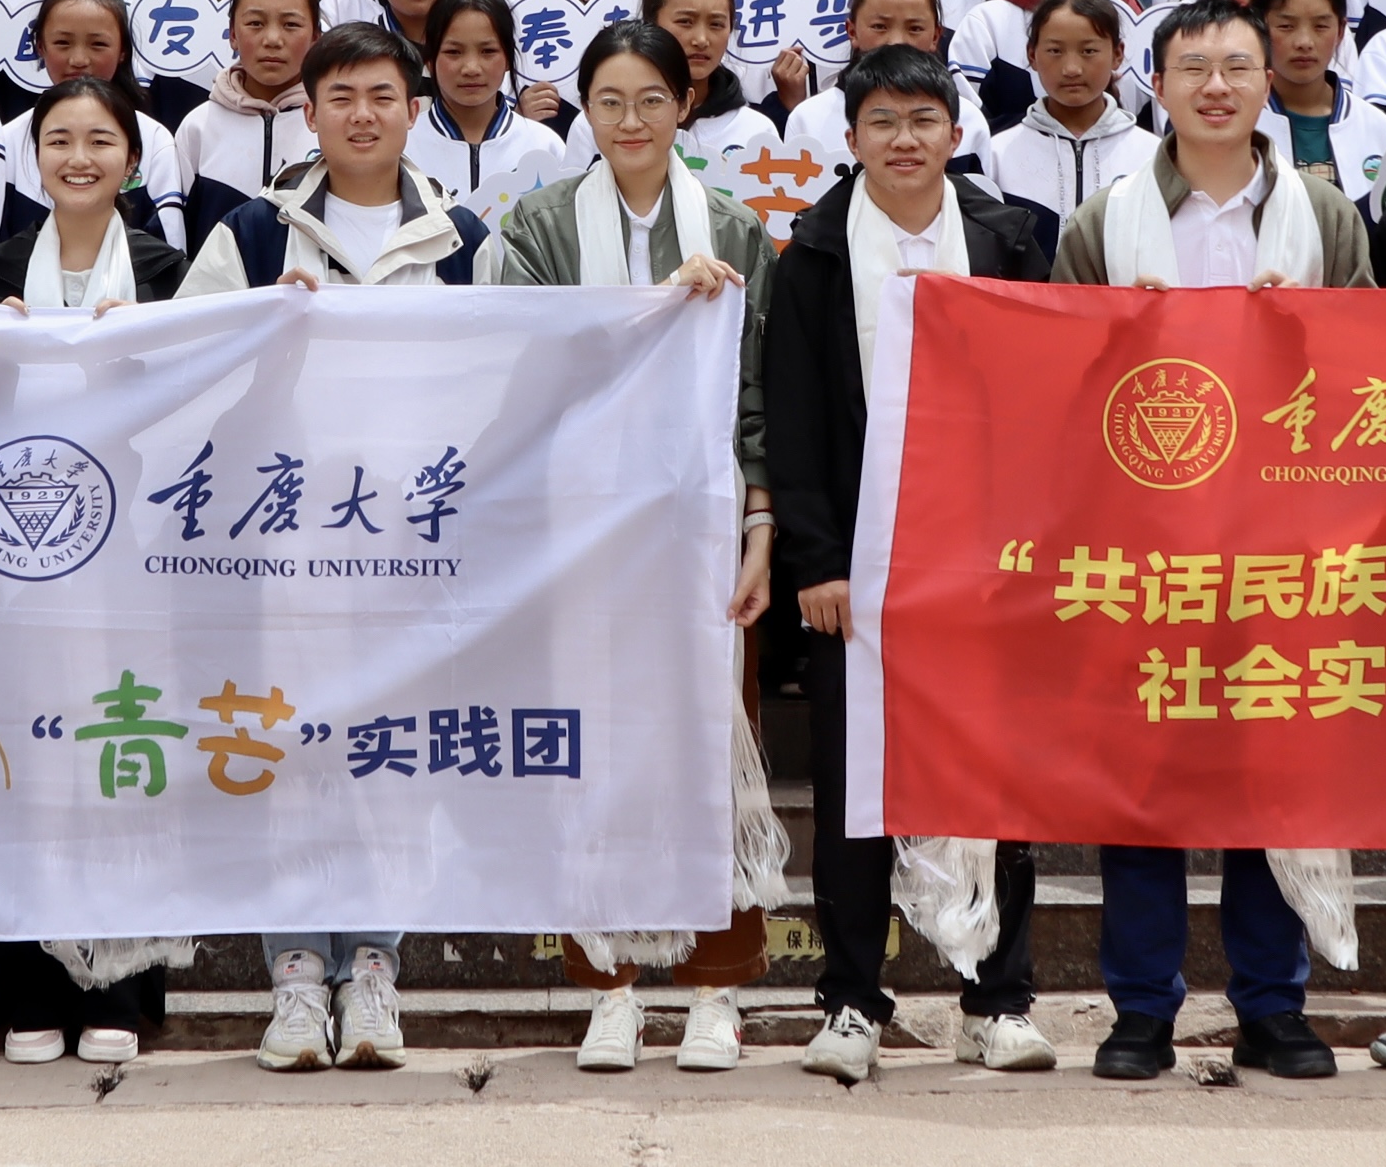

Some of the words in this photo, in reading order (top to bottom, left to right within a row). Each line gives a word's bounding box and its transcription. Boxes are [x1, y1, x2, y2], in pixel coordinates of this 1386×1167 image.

[1146, 407, 1196, 418] 1929
[1114, 402, 1165, 479] CHONGQING
[1172, 403, 1227, 479] UNIVERSITY
[6, 489, 65, 501] 1929
[39, 483, 103, 570] UNIVERSITY
[144, 554, 297, 580] CHONGQING
[307, 557, 462, 577] UNIVERSITY
[31, 669, 581, 799] “青芒”实践团
